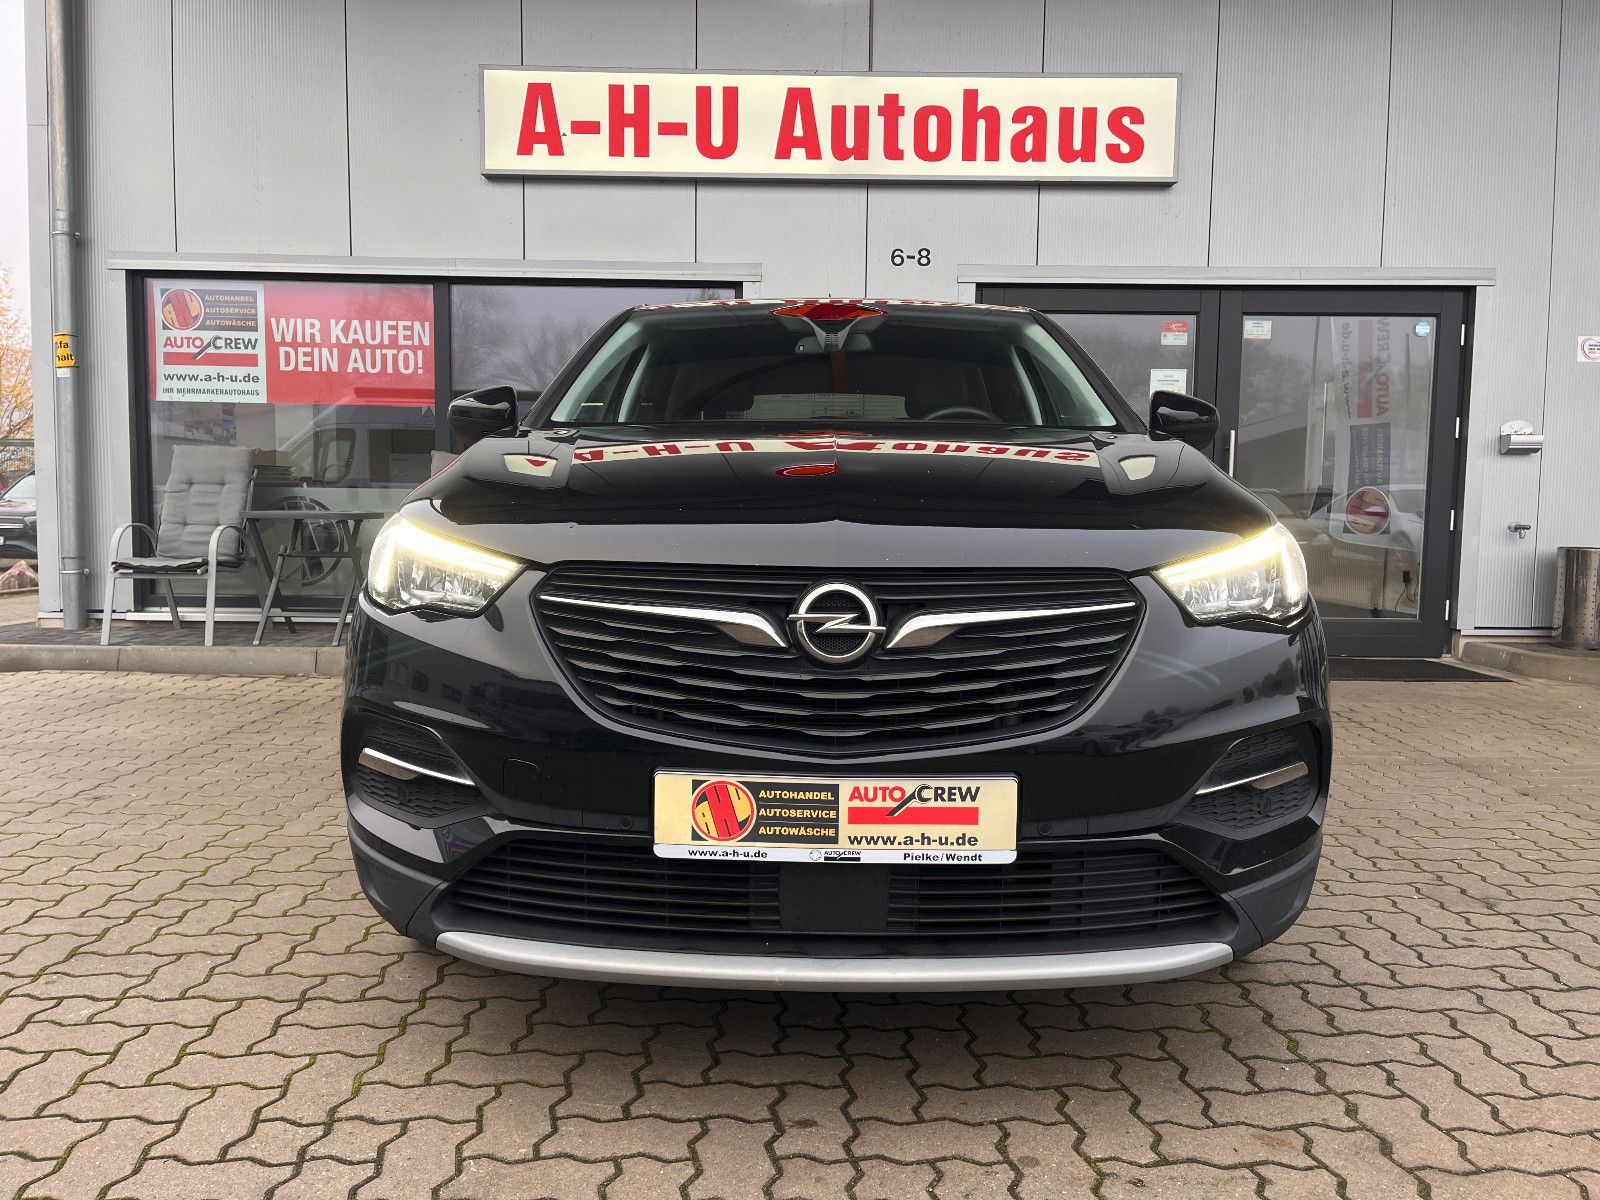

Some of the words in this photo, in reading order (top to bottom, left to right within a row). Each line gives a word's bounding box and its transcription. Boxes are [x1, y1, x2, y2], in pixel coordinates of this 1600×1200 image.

[516, 82, 739, 160] A-H-U
[774, 87, 1145, 164] Autohaus
[890, 247, 932, 267] 6-8
[204, 294, 255, 302] AUTOHANDEL
[205, 307, 257, 315] AUTOSERVICE
[270, 317, 322, 344] WIR
[330, 319, 430, 346] KAUFEN
[163, 336, 205, 349] AUTO
[211, 336, 259, 350] CREW
[279, 347, 339, 373] DEIN
[346, 348, 424, 375] AUTO!
[163, 372, 260, 383] www.a-h-u.de
[162, 387, 175, 395] IHR
[176, 388, 260, 397] MEHRMARKENAUTOHAUS
[759, 789, 835, 800] AUTOHANDEL
[848, 786, 906, 803] AUTO
[916, 784, 980, 803] CREW
[759, 808, 837, 819] AUTOSERVICE
[759, 826, 836, 837] AUTOWÄSCHE
[848, 833, 978, 847] www.a-h-u.de
[688, 849, 768, 859] www.a-h-u.de
[903, 852, 982, 862] Pielke/Wendt
